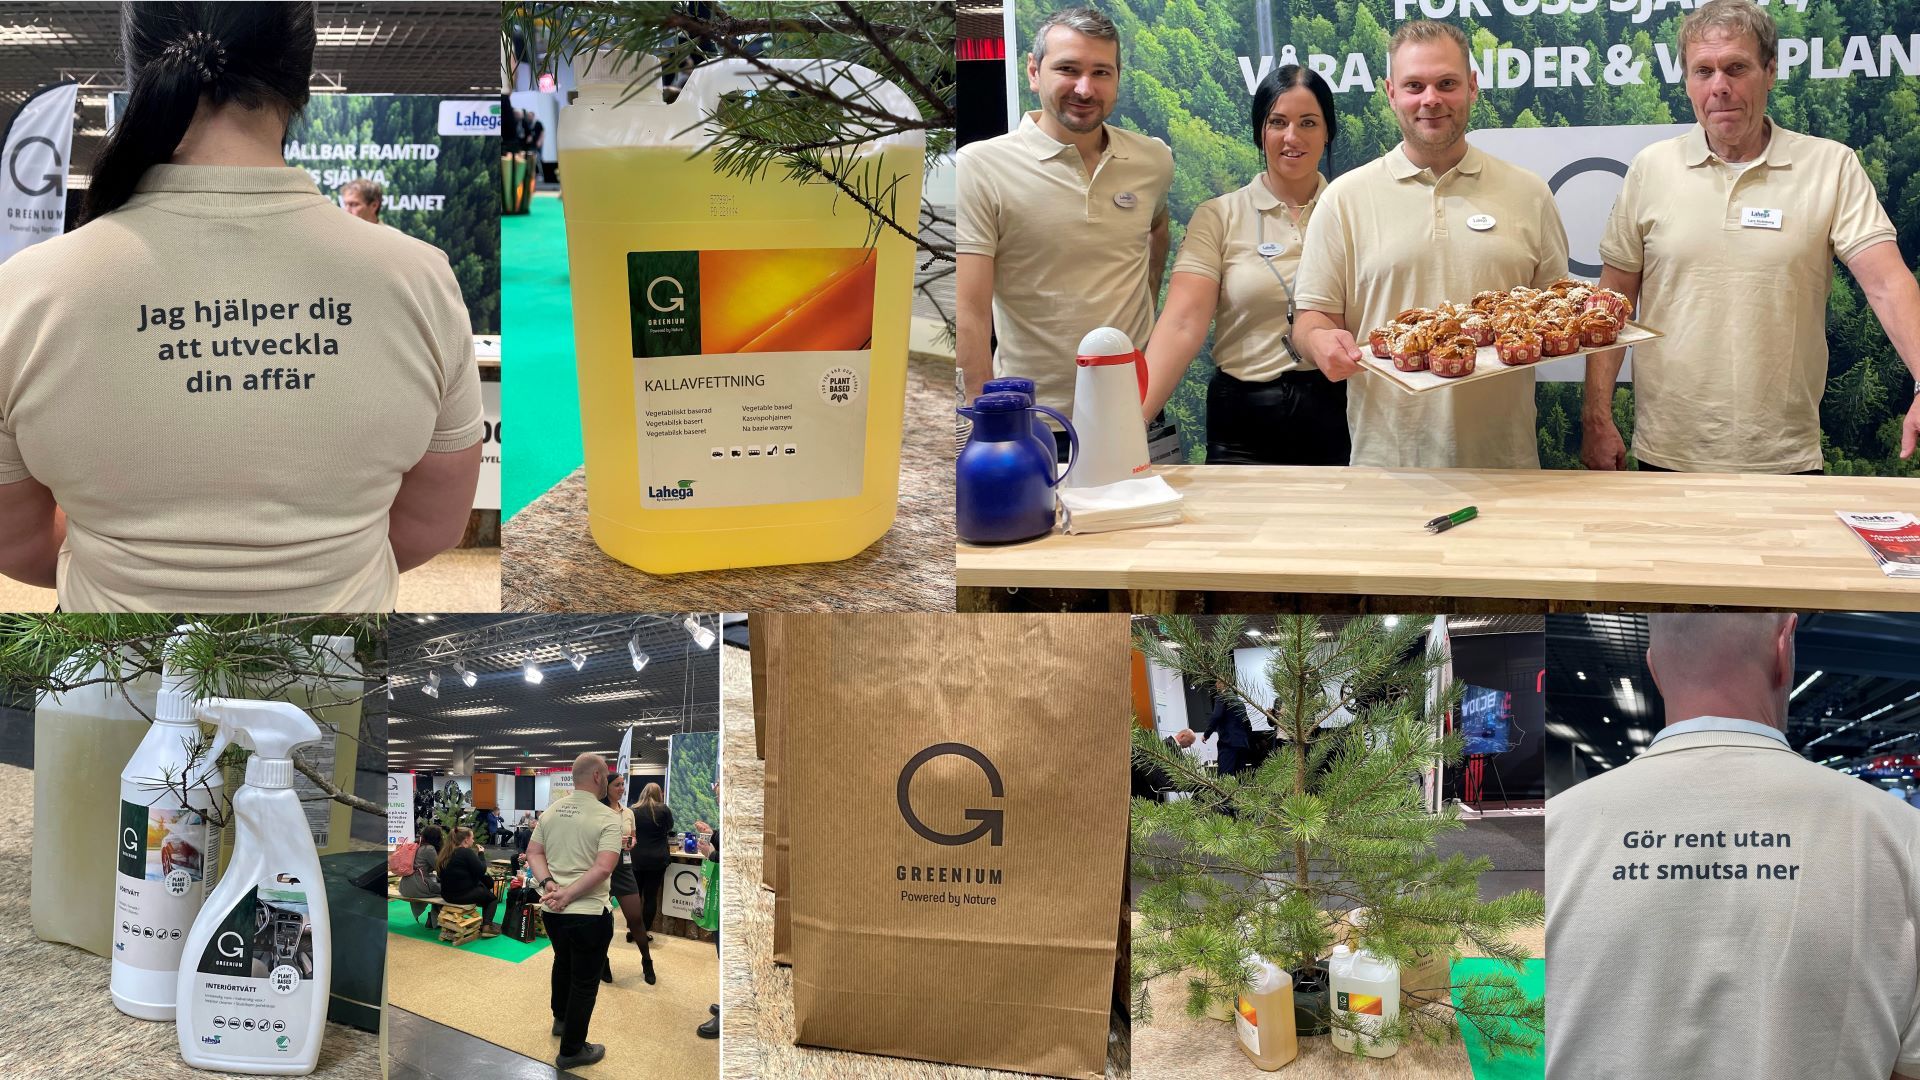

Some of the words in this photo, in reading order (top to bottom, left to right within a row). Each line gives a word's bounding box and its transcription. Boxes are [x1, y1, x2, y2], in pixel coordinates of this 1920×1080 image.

[1603, 44, 1644, 85] &
[360, 144, 441, 161] FRAMTID
[137, 304, 186, 332] Jag
[194, 299, 300, 328] hjälper
[309, 297, 352, 326] dig
[158, 338, 202, 361] att
[211, 333, 339, 357] utveckla
[186, 371, 232, 393] din
[242, 368, 316, 390] affär
[645, 374, 766, 392] KALLAVFETTNING
[829, 385, 851, 393] BASED
[830, 377, 851, 385] PLANT
[742, 404, 773, 412] Vegetable
[648, 485, 694, 500] Lahega
[1623, 830, 1667, 849] Gör
[1674, 830, 1726, 848] rent
[1734, 830, 1791, 847] utan
[896, 865, 1003, 885] GREENIUM
[1612, 862, 1650, 880] att
[1656, 862, 1748, 880] smutsa
[1756, 864, 1800, 881] ner
[901, 890, 946, 904] Powered
[948, 892, 961, 907] by
[963, 893, 997, 905] Nature
[205, 982, 257, 993] INTERIÖRTVÄTT
